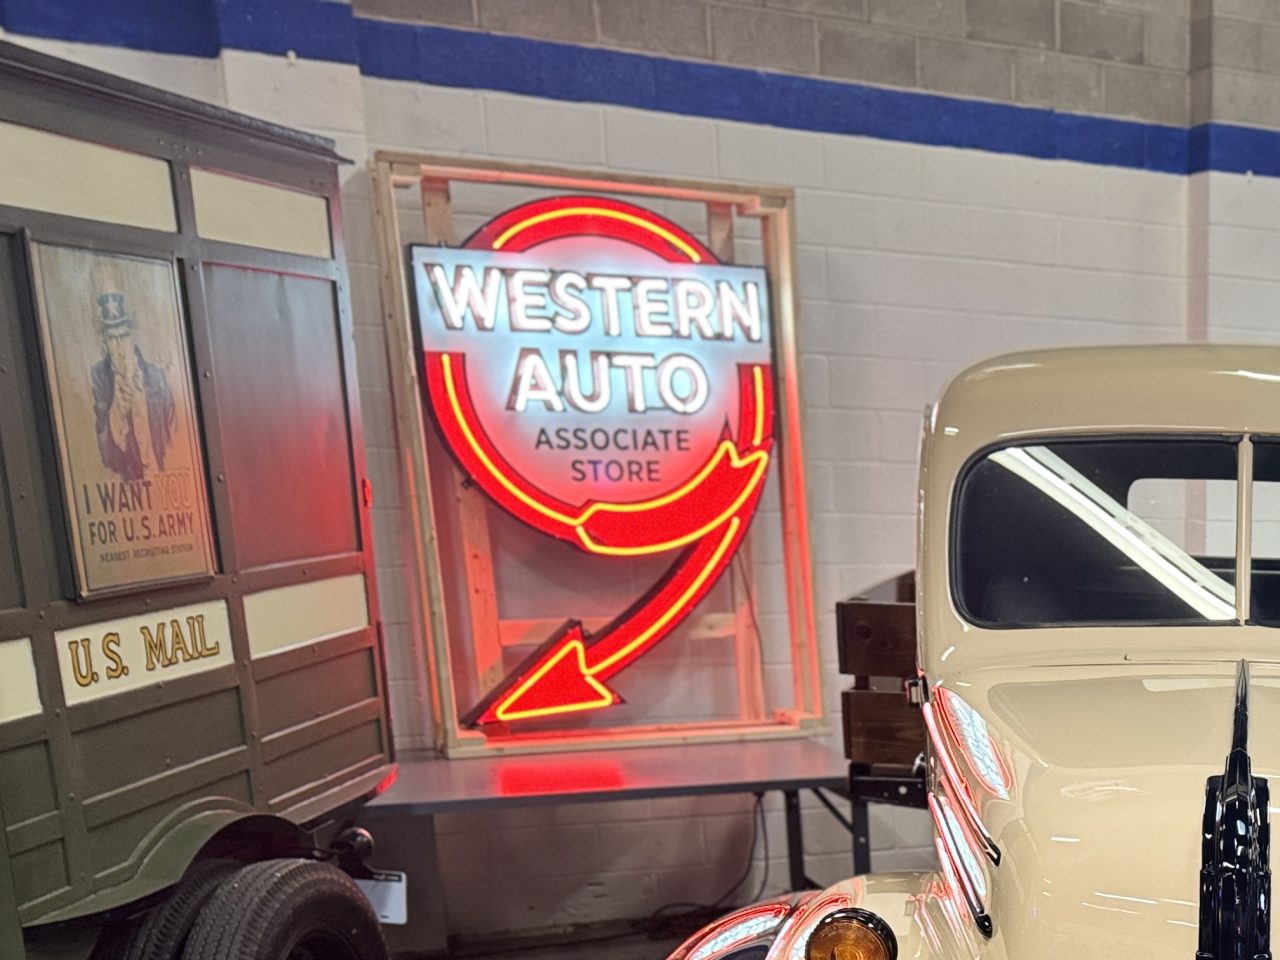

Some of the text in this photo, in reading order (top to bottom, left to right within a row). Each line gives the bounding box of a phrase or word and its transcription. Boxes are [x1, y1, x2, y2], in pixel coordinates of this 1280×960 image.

[424, 263, 762, 341] WESTERN
[505, 348, 711, 414] AUTO
[534, 427, 691, 451] ASSOCIATE
[83, 470, 193, 515] I WANT YOU
[571, 460, 661, 482] STORE
[88, 520, 118, 545] FOR
[158, 511, 194, 538] ARMY
[68, 614, 220, 687] U.S. MAIL
